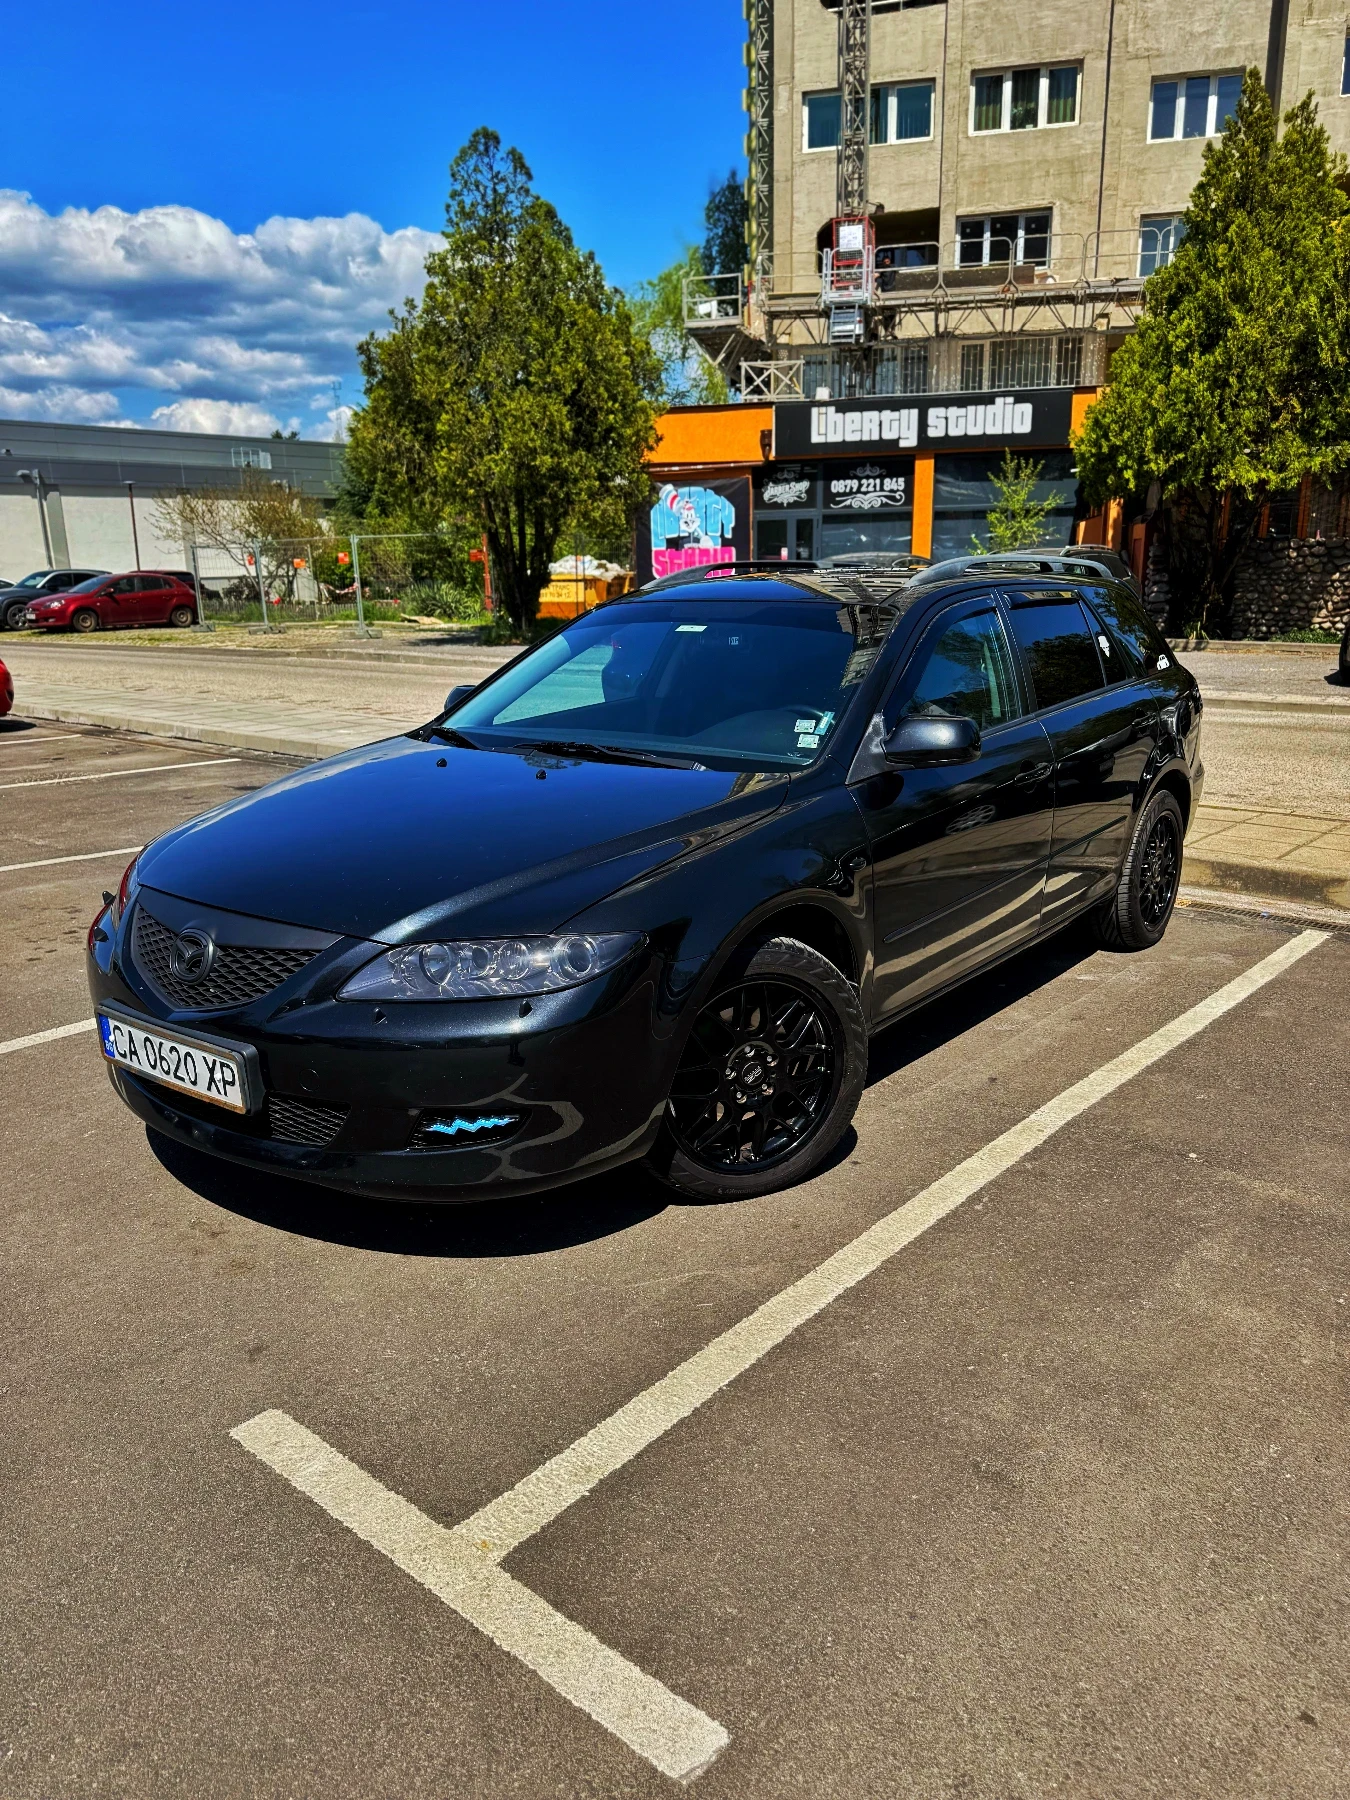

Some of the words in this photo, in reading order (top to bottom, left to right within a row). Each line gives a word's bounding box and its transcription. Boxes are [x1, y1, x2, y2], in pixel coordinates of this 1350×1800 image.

[927, 397, 1033, 438] studio
[831, 479, 859, 493] 0879
[860, 478, 880, 492] 221
[883, 477, 905, 491] 845
[104, 1040, 115, 1053] BG
[113, 1024, 142, 1067] CA
[143, 1035, 198, 1087] 0620
[202, 1055, 236, 1098] XP
